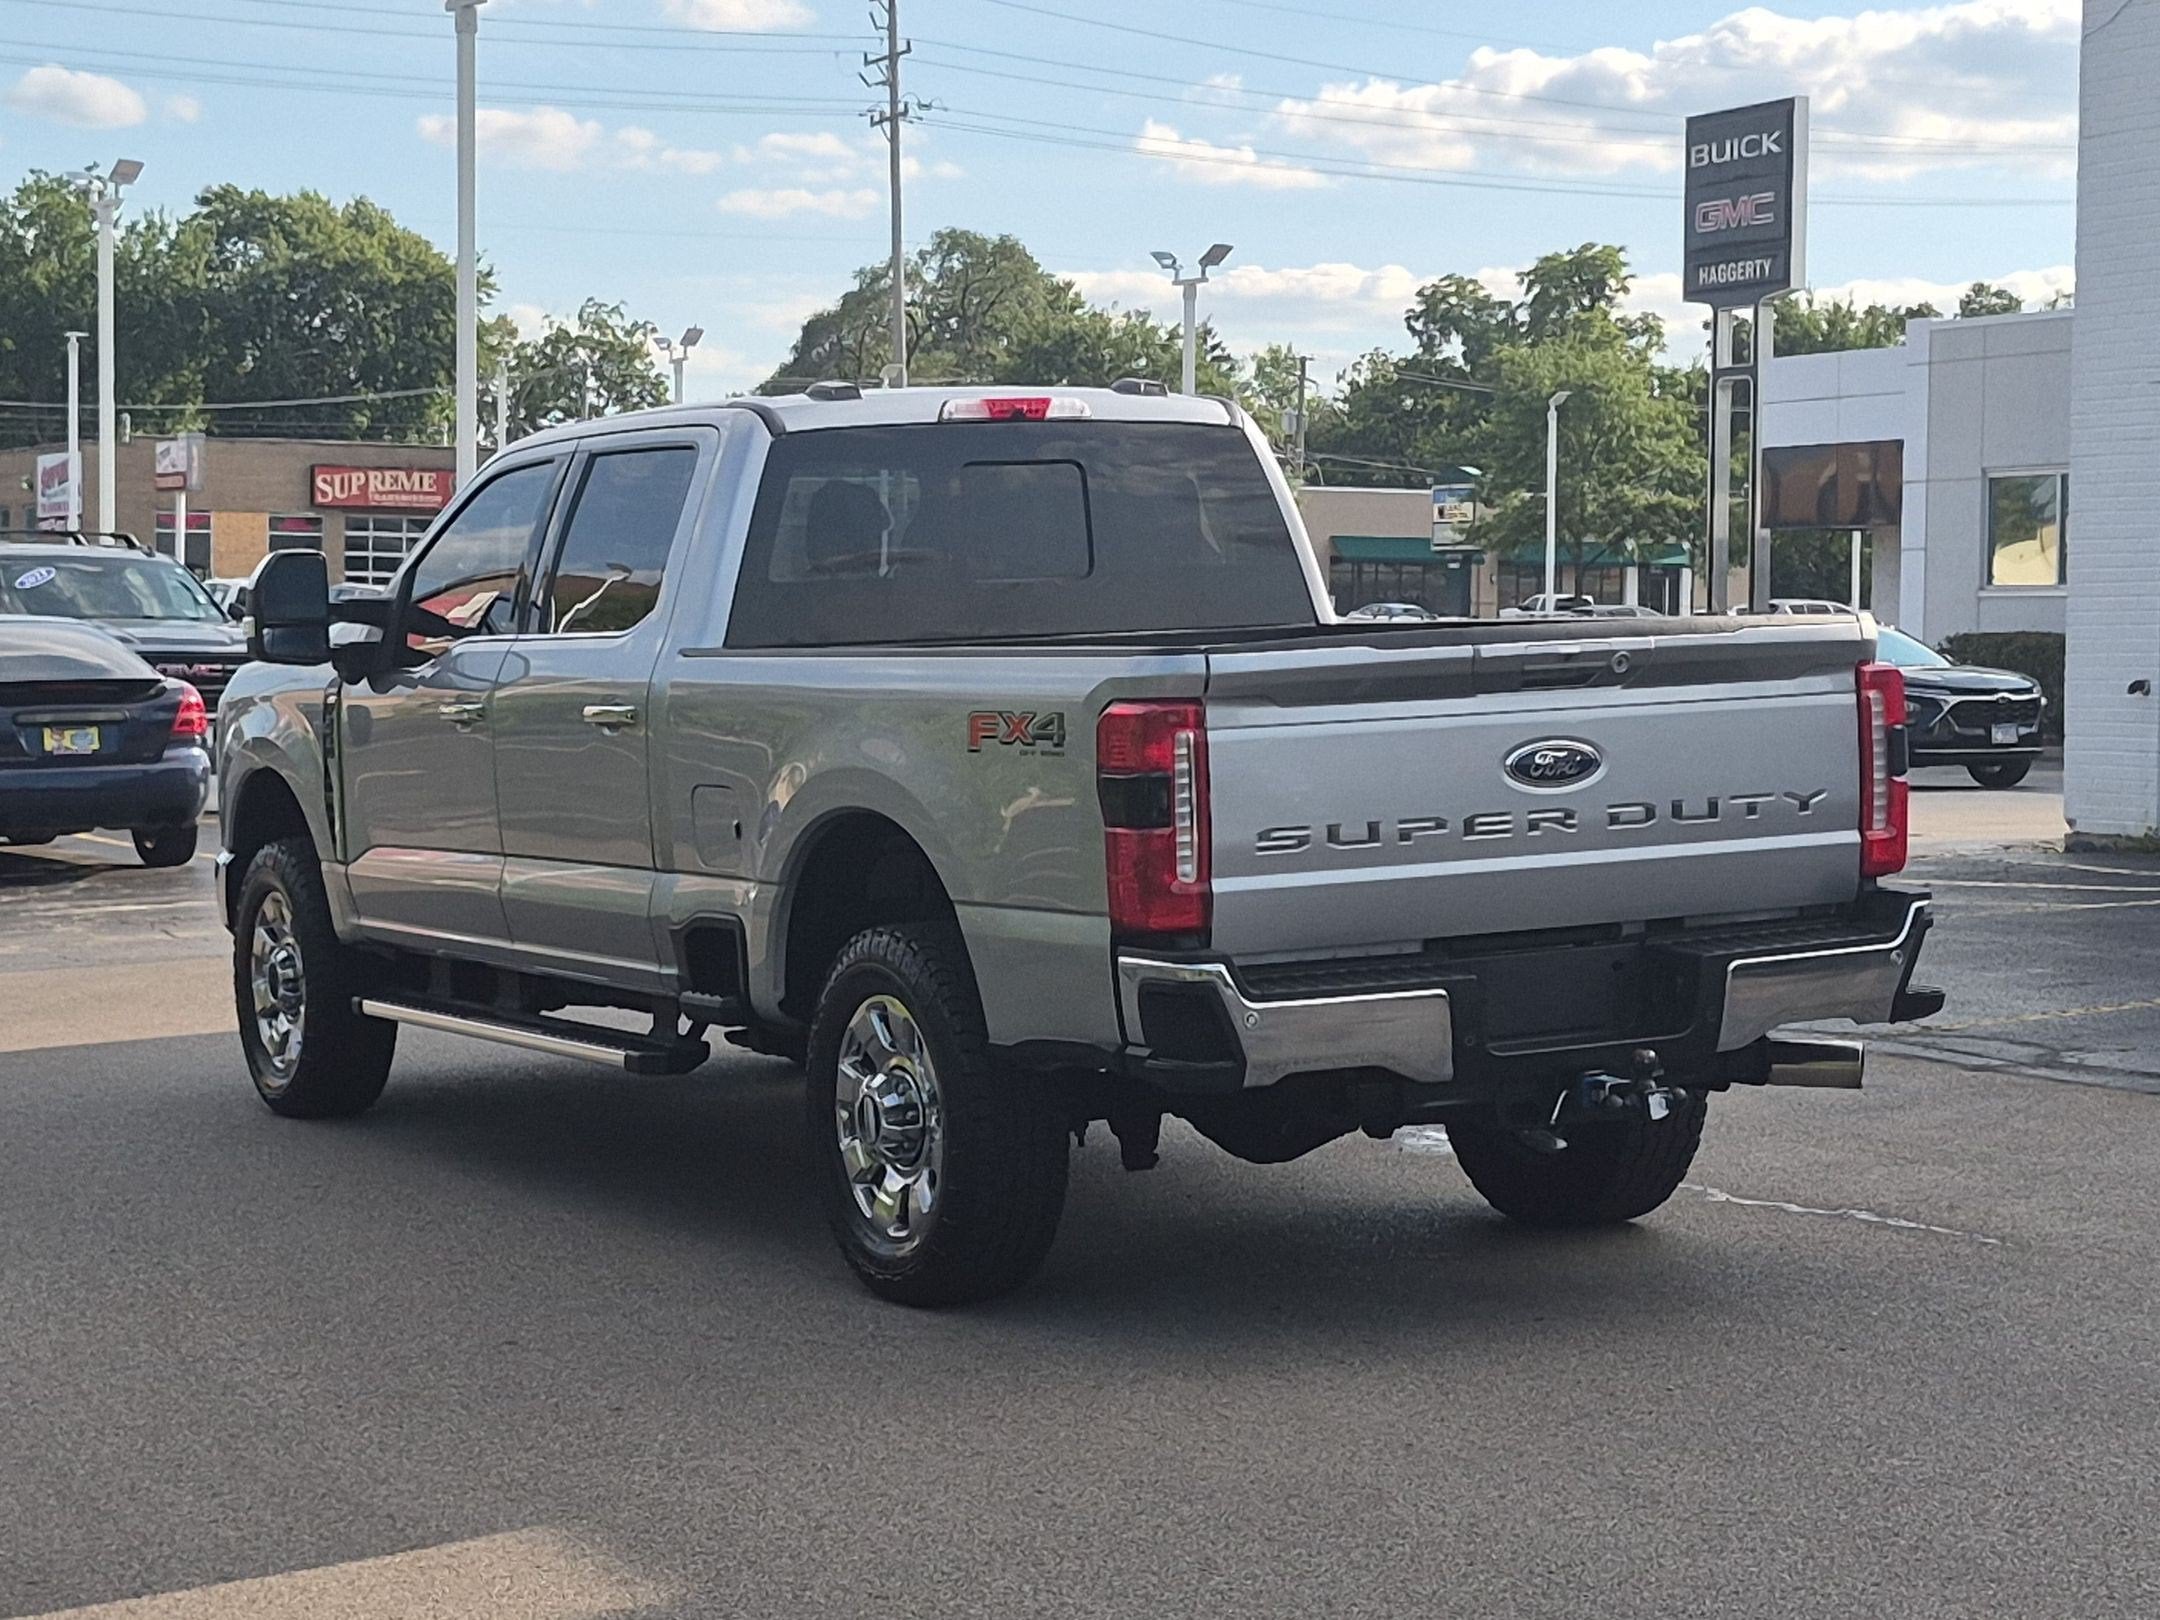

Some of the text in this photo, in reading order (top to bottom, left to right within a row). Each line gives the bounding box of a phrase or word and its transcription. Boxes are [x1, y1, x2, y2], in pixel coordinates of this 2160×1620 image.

[1690, 130, 1782, 168] BUICK
[1695, 192, 1775, 233] GMC
[1699, 257, 1772, 286] HAGGERTY
[316, 471, 437, 503] SUPREME
[967, 711, 1065, 752] FX4
[1530, 750, 1581, 777] Ford
[1255, 788, 1828, 855] SUPER DUTY
